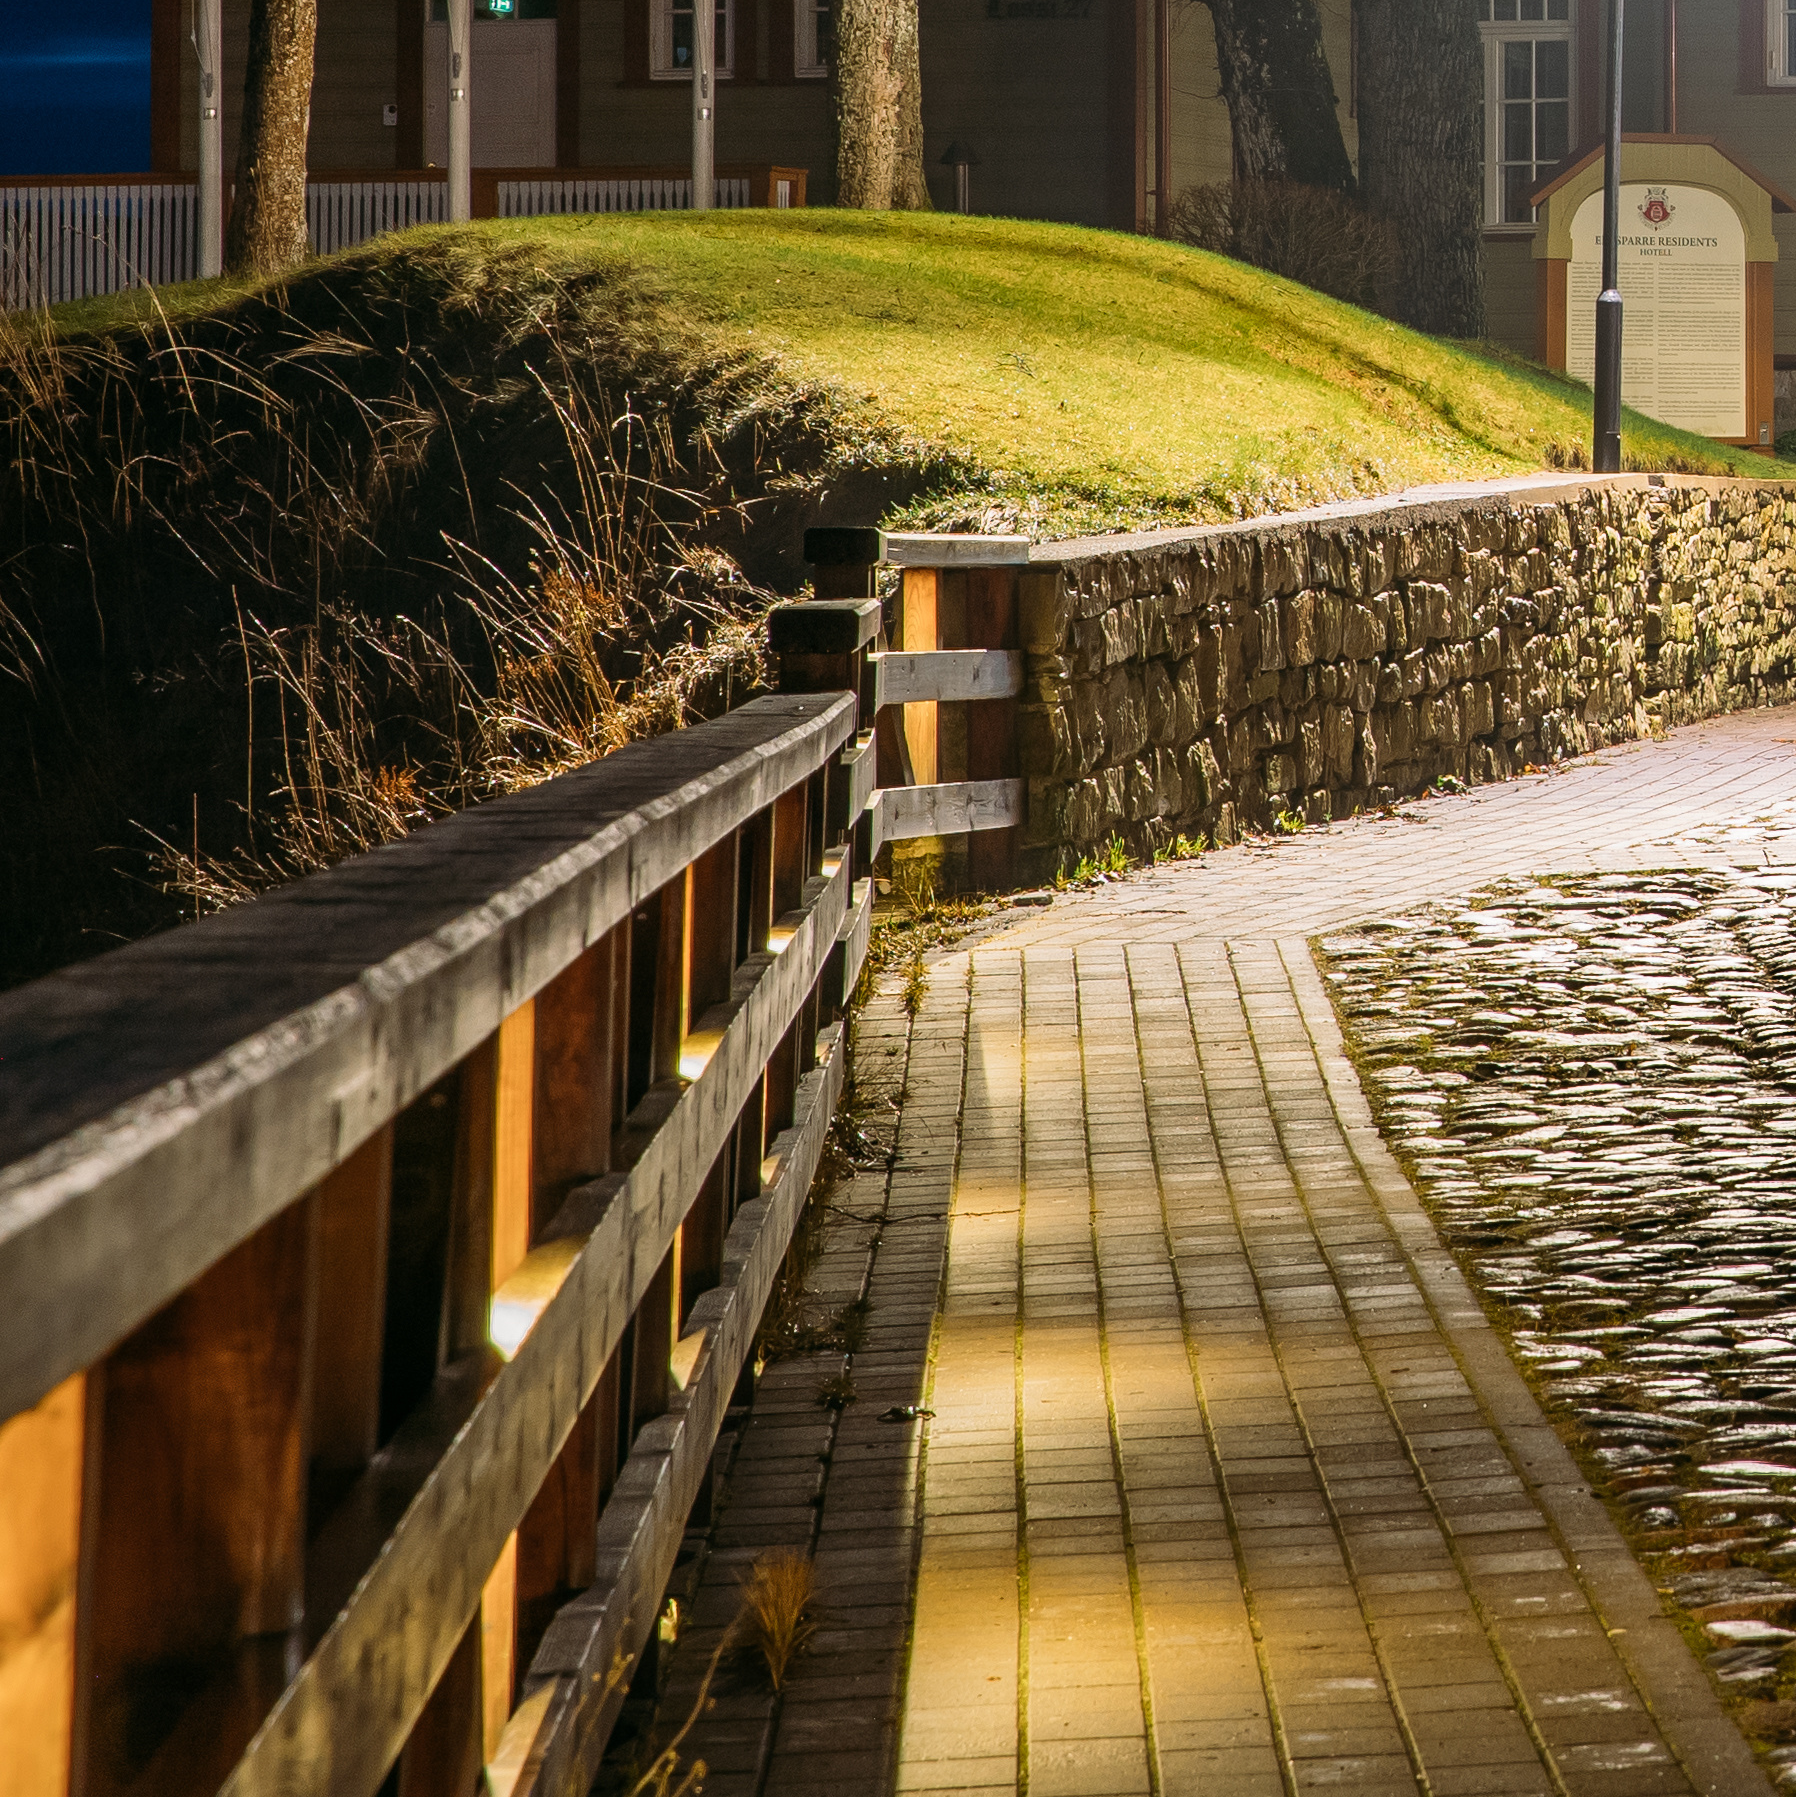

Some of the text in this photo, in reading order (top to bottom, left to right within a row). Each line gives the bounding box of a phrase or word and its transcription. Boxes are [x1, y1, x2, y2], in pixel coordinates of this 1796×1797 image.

[1594, 235, 1718, 248] ESPARRE RESIDENTS
[1639, 248, 1673, 257] HOTELL
